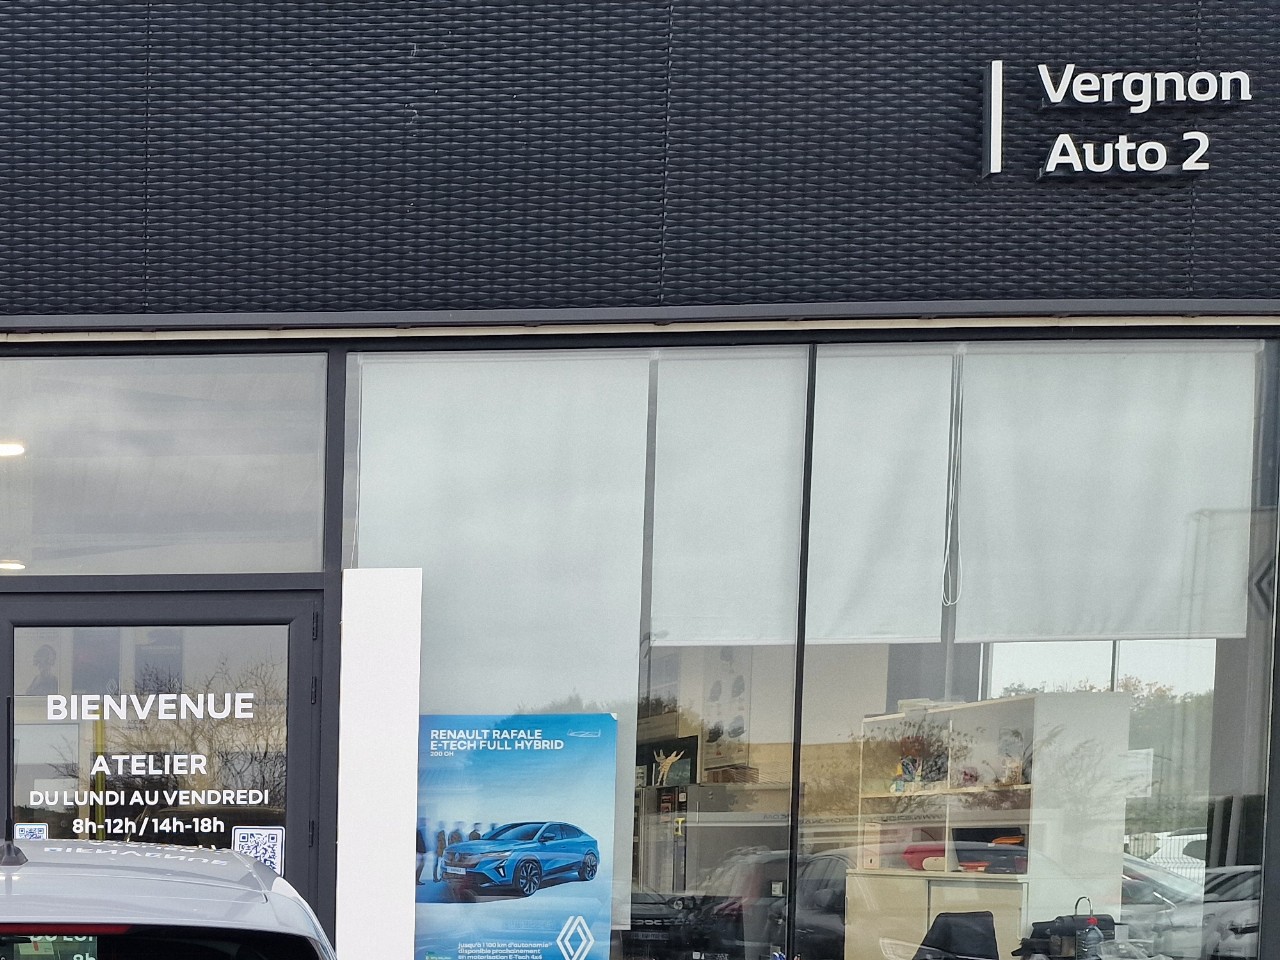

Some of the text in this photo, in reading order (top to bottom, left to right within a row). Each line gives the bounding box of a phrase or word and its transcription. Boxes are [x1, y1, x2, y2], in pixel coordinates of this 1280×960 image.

[1038, 63, 1252, 113] Vergnon
[1045, 131, 1210, 172] Auto 2
[47, 693, 254, 720] BIENVENUE
[430, 729, 542, 740] RENAULT RAFALE
[430, 739, 564, 750] E-TECH FULL HYBRID
[90, 755, 208, 775] ATELIER
[29, 789, 269, 806] DU LUNDI AU VENDREDI
